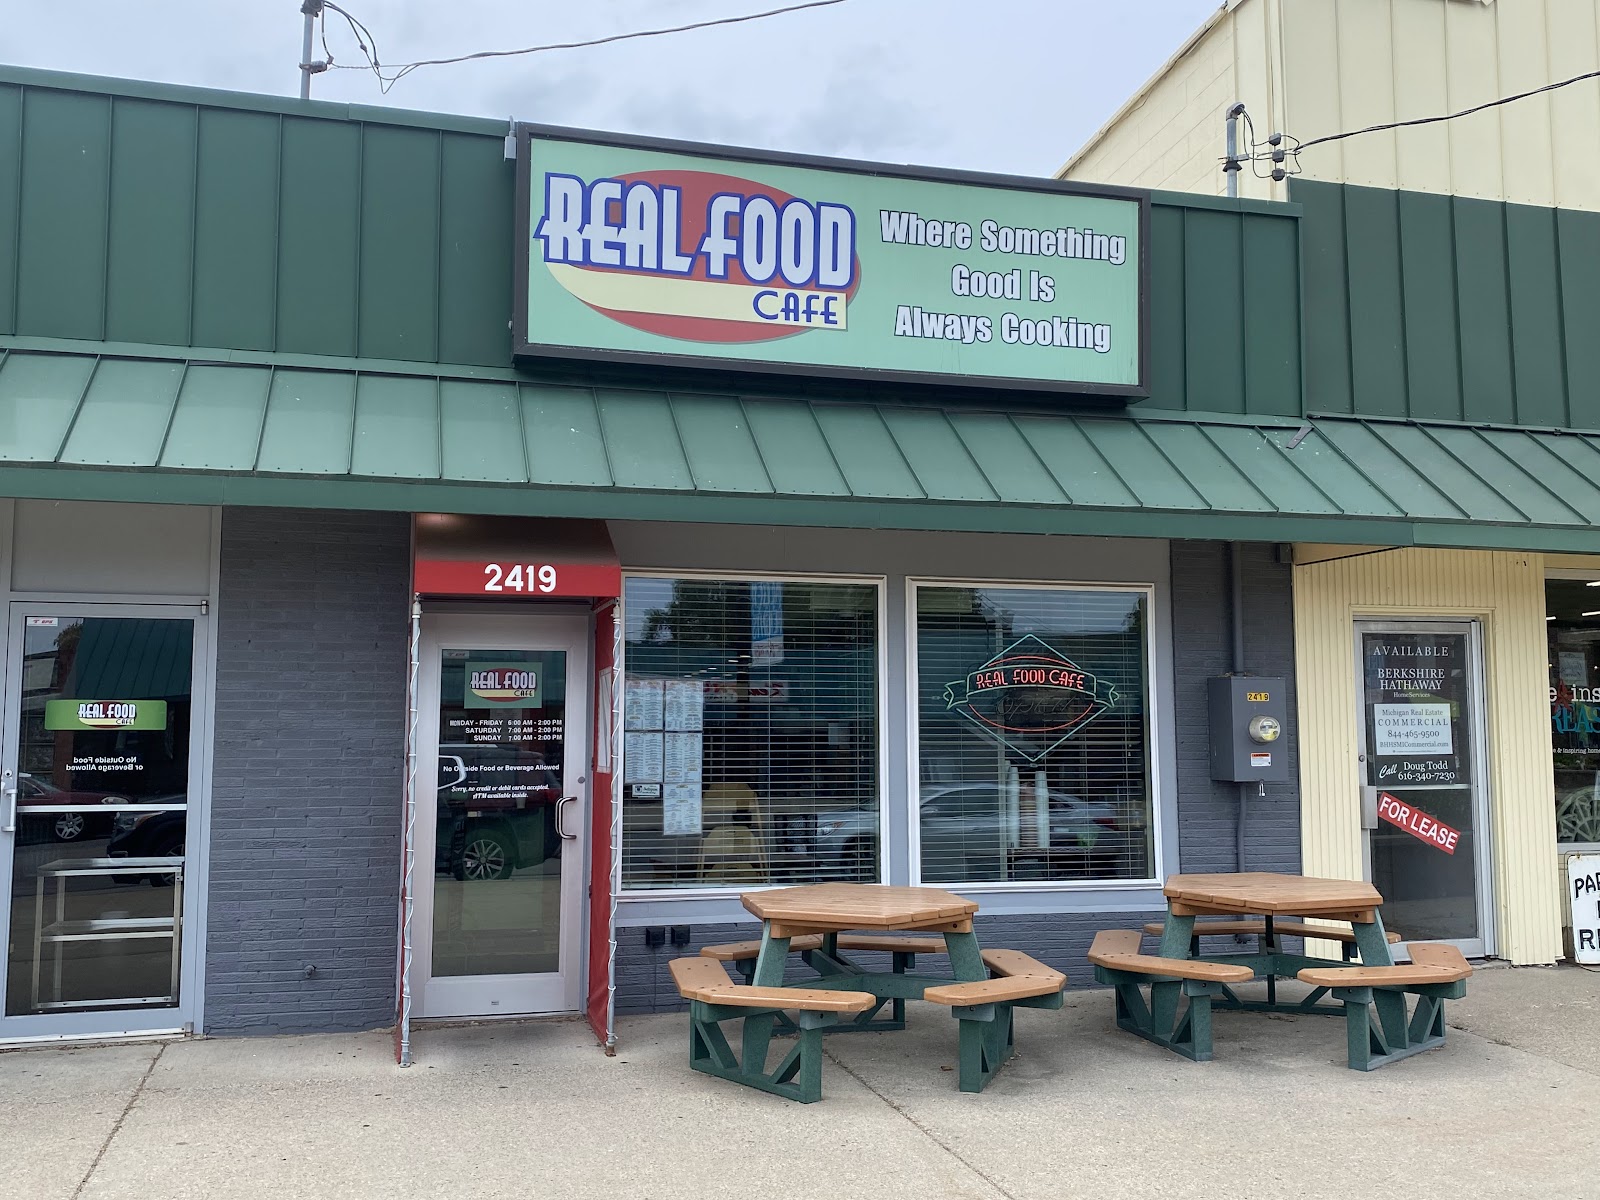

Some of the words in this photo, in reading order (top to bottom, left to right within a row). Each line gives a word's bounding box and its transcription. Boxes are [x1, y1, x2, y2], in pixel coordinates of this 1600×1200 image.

[533, 172, 697, 276] REAL
[700, 192, 857, 290] FOOD
[879, 209, 972, 250] Where
[980, 219, 1127, 265] Something
[951, 264, 1022, 300] Good
[1029, 269, 1056, 303] Is
[752, 290, 839, 325] CAFE
[893, 304, 993, 345] Always
[1000, 312, 1112, 353] Cooking
[484, 563, 557, 593] 2419
[1373, 646, 1449, 656] AVAILABLE
[469, 671, 502, 689] REAL
[503, 671, 537, 689] FOOD
[975, 671, 1008, 689] REAL
[1012, 669, 1046, 684] FOOD
[1048, 669, 1085, 689] CAFE
[1377, 667, 1445, 679] BERKSHIRE
[1380, 679, 1443, 690] HATHAWAY
[513, 689, 534, 697] CAFE
[78, 703, 106, 718] REAL
[106, 703, 136, 718] FOOD
[1382, 709, 1409, 717] Michigan
[1378, 718, 1448, 726] COMMERCIAL
[1387, 730, 1440, 738] 844-465-9500
[1379, 764, 1398, 778] Call
[1403, 761, 1426, 772] Doug
[1426, 760, 1448, 770] Todd
[1398, 771, 1455, 781] 616-340-7230
[1379, 796, 1410, 825] FOR
[1410, 813, 1458, 850] LEASE
